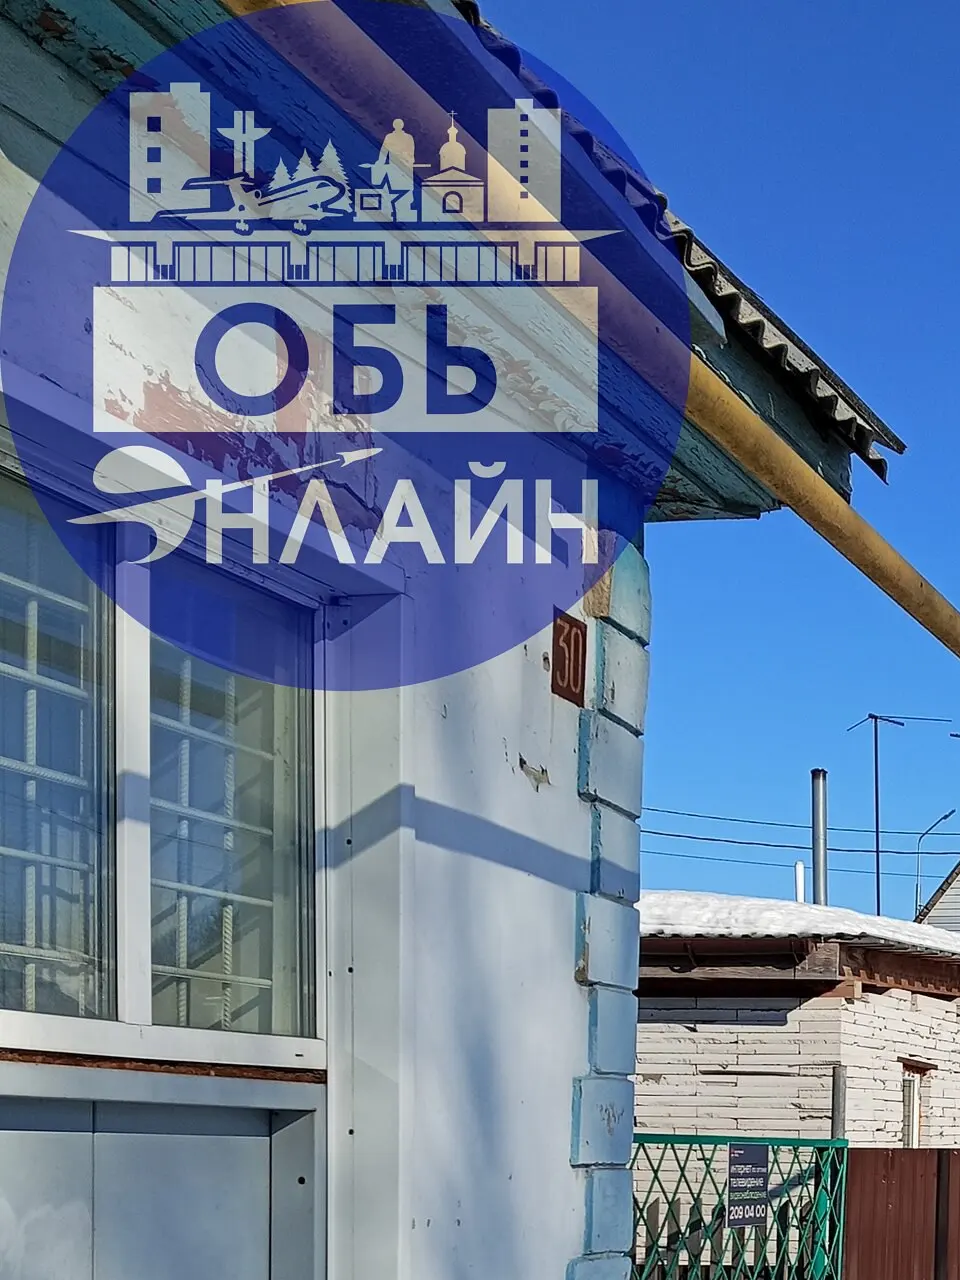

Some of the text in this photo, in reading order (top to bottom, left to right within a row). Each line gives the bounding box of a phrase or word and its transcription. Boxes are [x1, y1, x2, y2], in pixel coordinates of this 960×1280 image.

[556, 617, 583, 694] 30
[729, 1204, 766, 1219] 209 04 00
